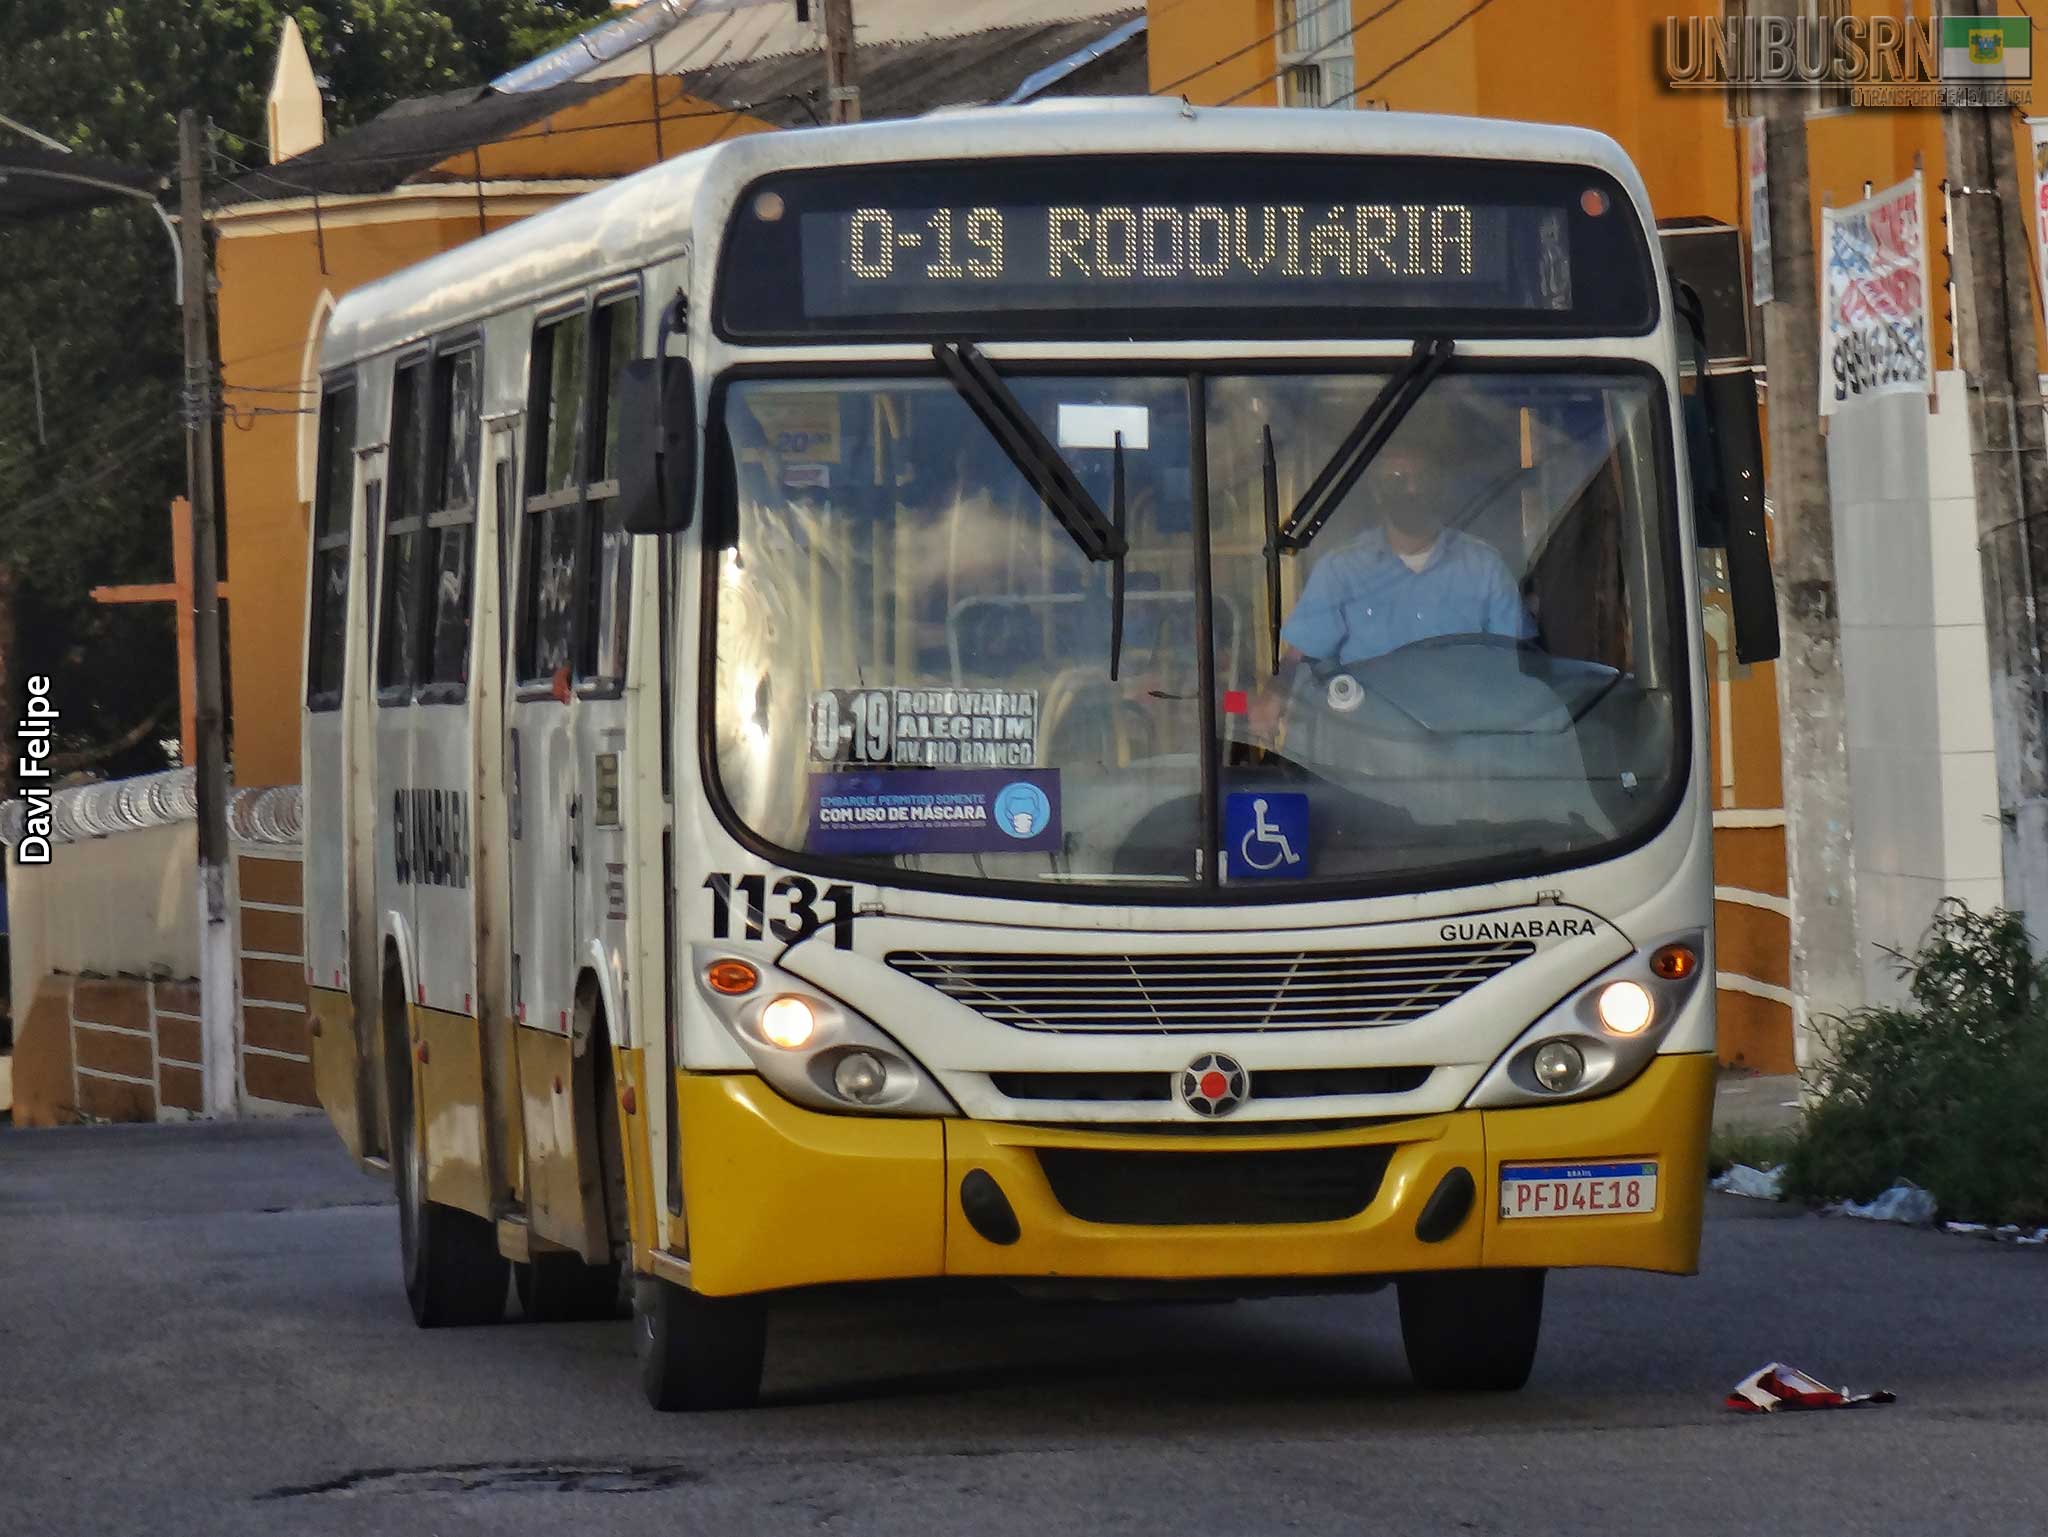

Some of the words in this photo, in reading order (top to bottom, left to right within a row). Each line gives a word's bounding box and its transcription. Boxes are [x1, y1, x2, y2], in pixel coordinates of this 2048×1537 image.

[851, 208, 1004, 278] 0-19
[815, 690, 890, 760] 0-19
[960, 742, 1032, 764] BRANCO
[820, 808, 853, 822] COM
[855, 807, 886, 821] USO
[888, 807, 909, 821] DE
[911, 803, 987, 821] MÁSCARA
[703, 872, 853, 951] 1131
[1440, 919, 1596, 941] GUANABARA
[1517, 1181, 1640, 1212] PFD4E18
